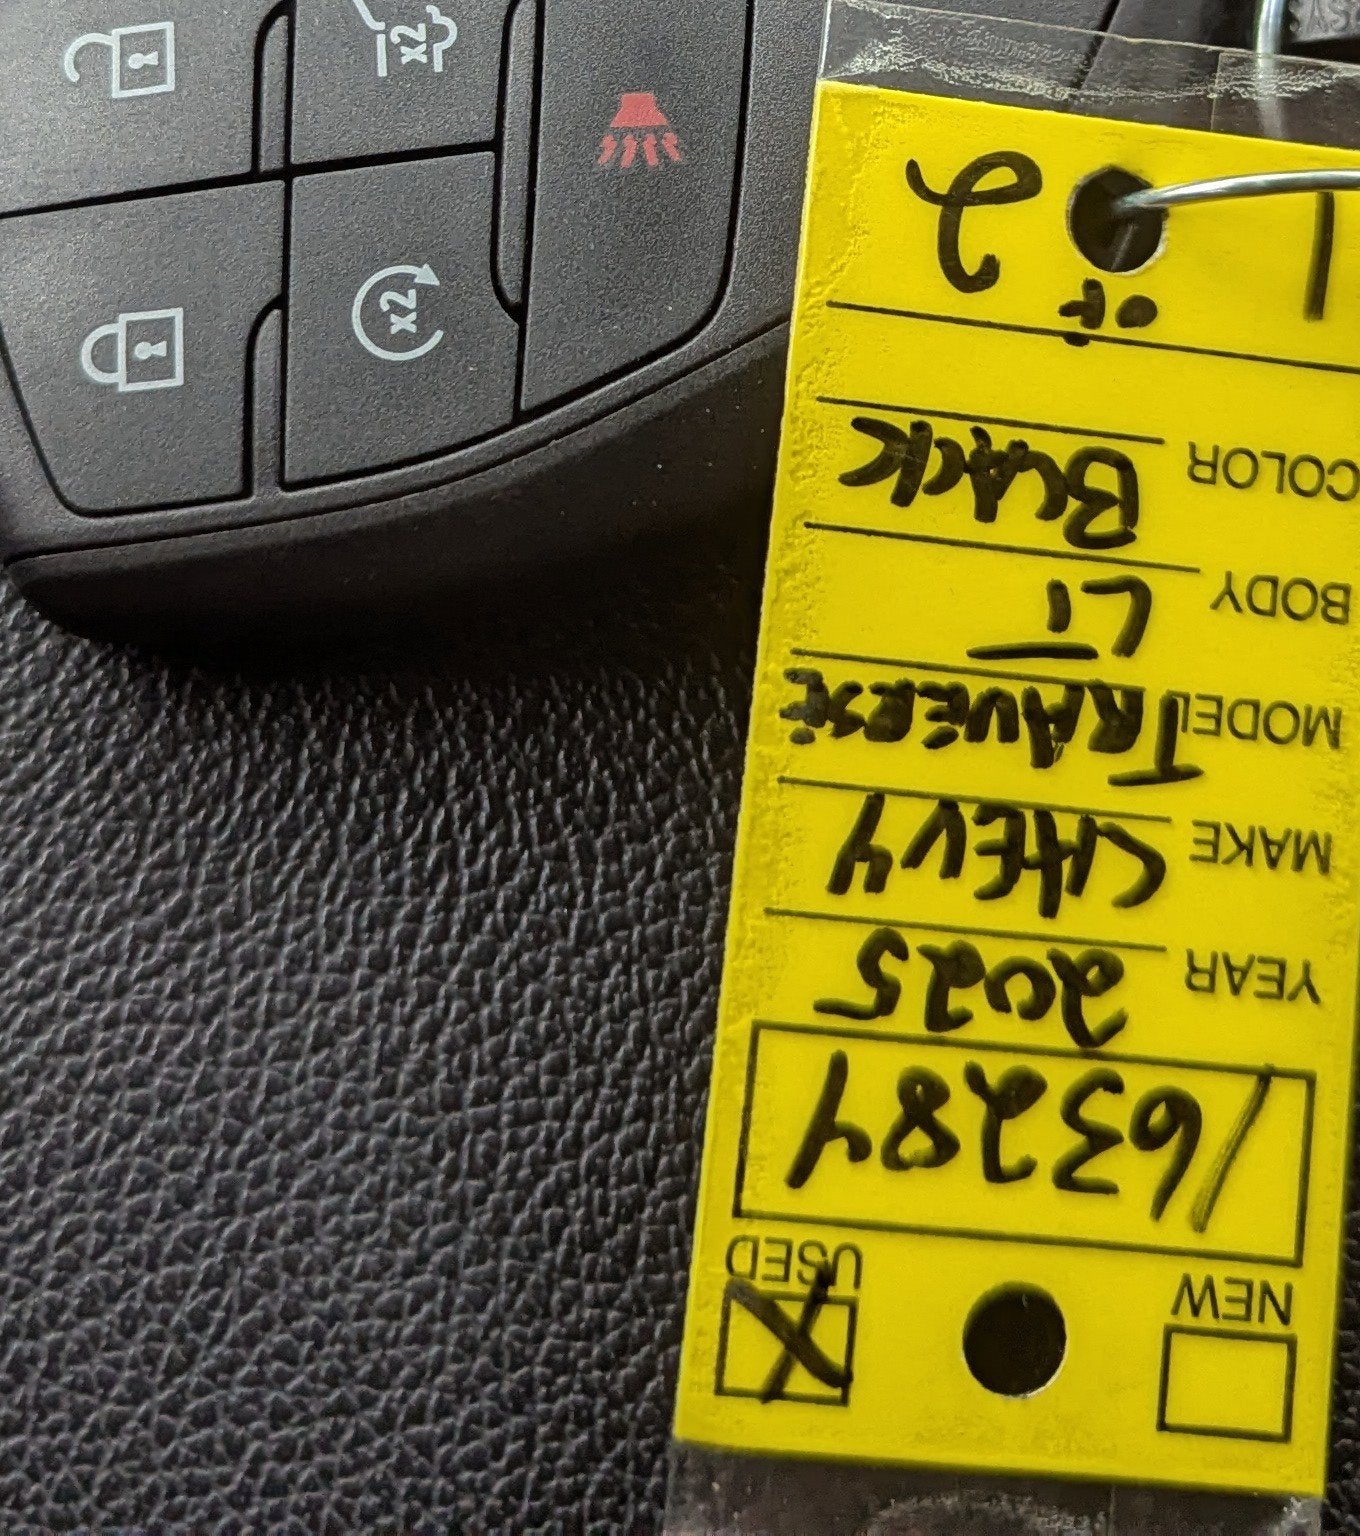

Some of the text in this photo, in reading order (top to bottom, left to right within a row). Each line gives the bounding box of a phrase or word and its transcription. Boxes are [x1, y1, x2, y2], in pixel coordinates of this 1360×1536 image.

[905, 150, 1043, 293] 2
[380, 289, 417, 334] x2
[839, 417, 1139, 549] BLACK
[1188, 440, 1360, 502] COLOR
[966, 576, 1152, 660] LT
[1210, 570, 1351, 624] BODY
[780, 669, 1204, 787] TRAVERSE
[1172, 691, 1342, 749] MODEL
[827, 792, 1167, 918] CHEVY
[1190, 820, 1332, 875] MAKE
[813, 927, 1128, 1049] 2025
[1185, 948, 1323, 1005] YEAR
[785, 1050, 1274, 1233] 163284
[726, 1235, 863, 1290] USED
[1171, 1272, 1294, 1326] NEW
